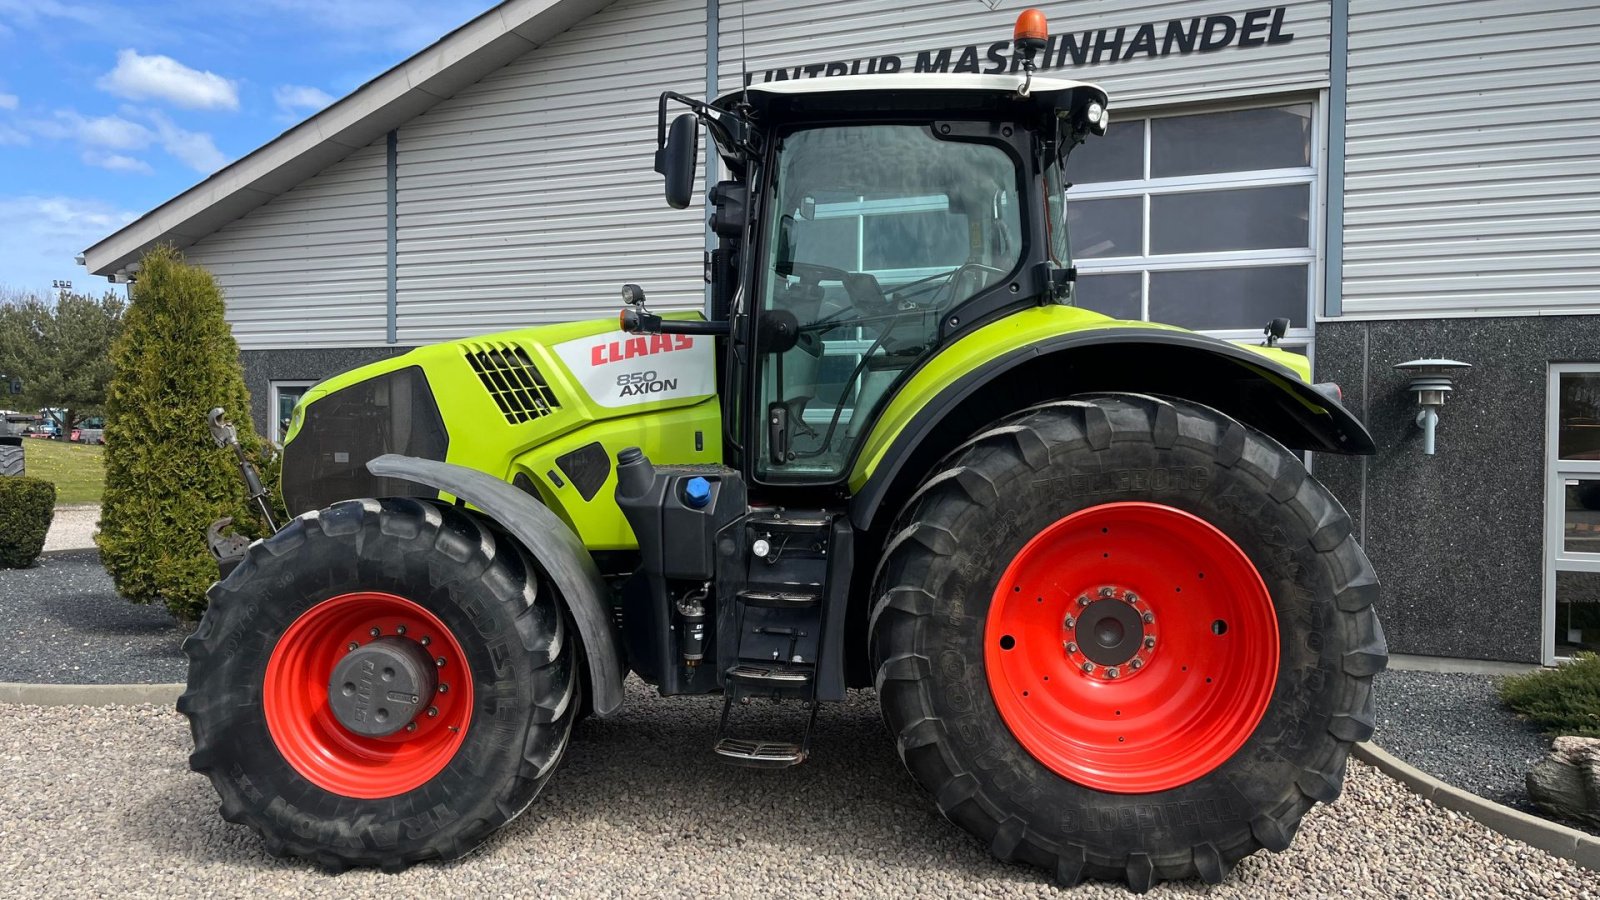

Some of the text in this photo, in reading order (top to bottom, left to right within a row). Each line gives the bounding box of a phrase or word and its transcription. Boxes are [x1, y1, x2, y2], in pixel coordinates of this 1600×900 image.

[591, 333, 693, 366] CLAAS
[616, 371, 658, 387] 850
[619, 378, 678, 398] AXION
